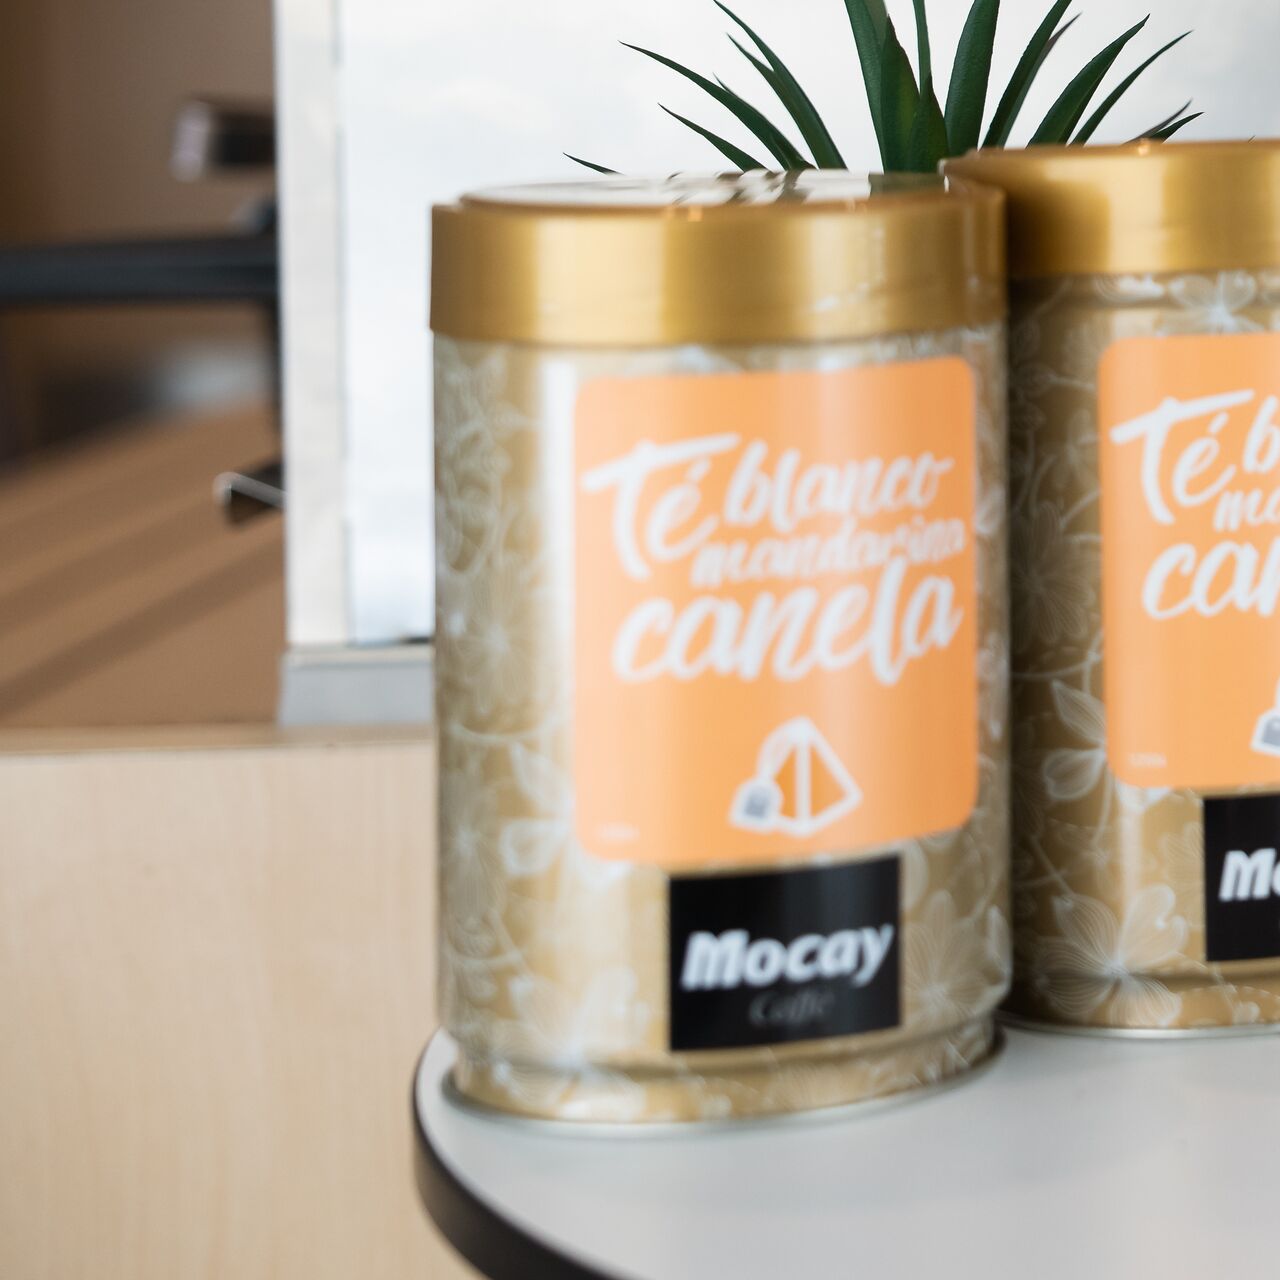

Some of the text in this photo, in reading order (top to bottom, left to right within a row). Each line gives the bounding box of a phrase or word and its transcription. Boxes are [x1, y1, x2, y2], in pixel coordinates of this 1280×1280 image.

[581, 431, 954, 581] Té blanco
[1110, 388, 1254, 526] Té
[690, 514, 967, 588] mandarina
[612, 555, 965, 685] canela
[680, 923, 895, 991] Mocay
